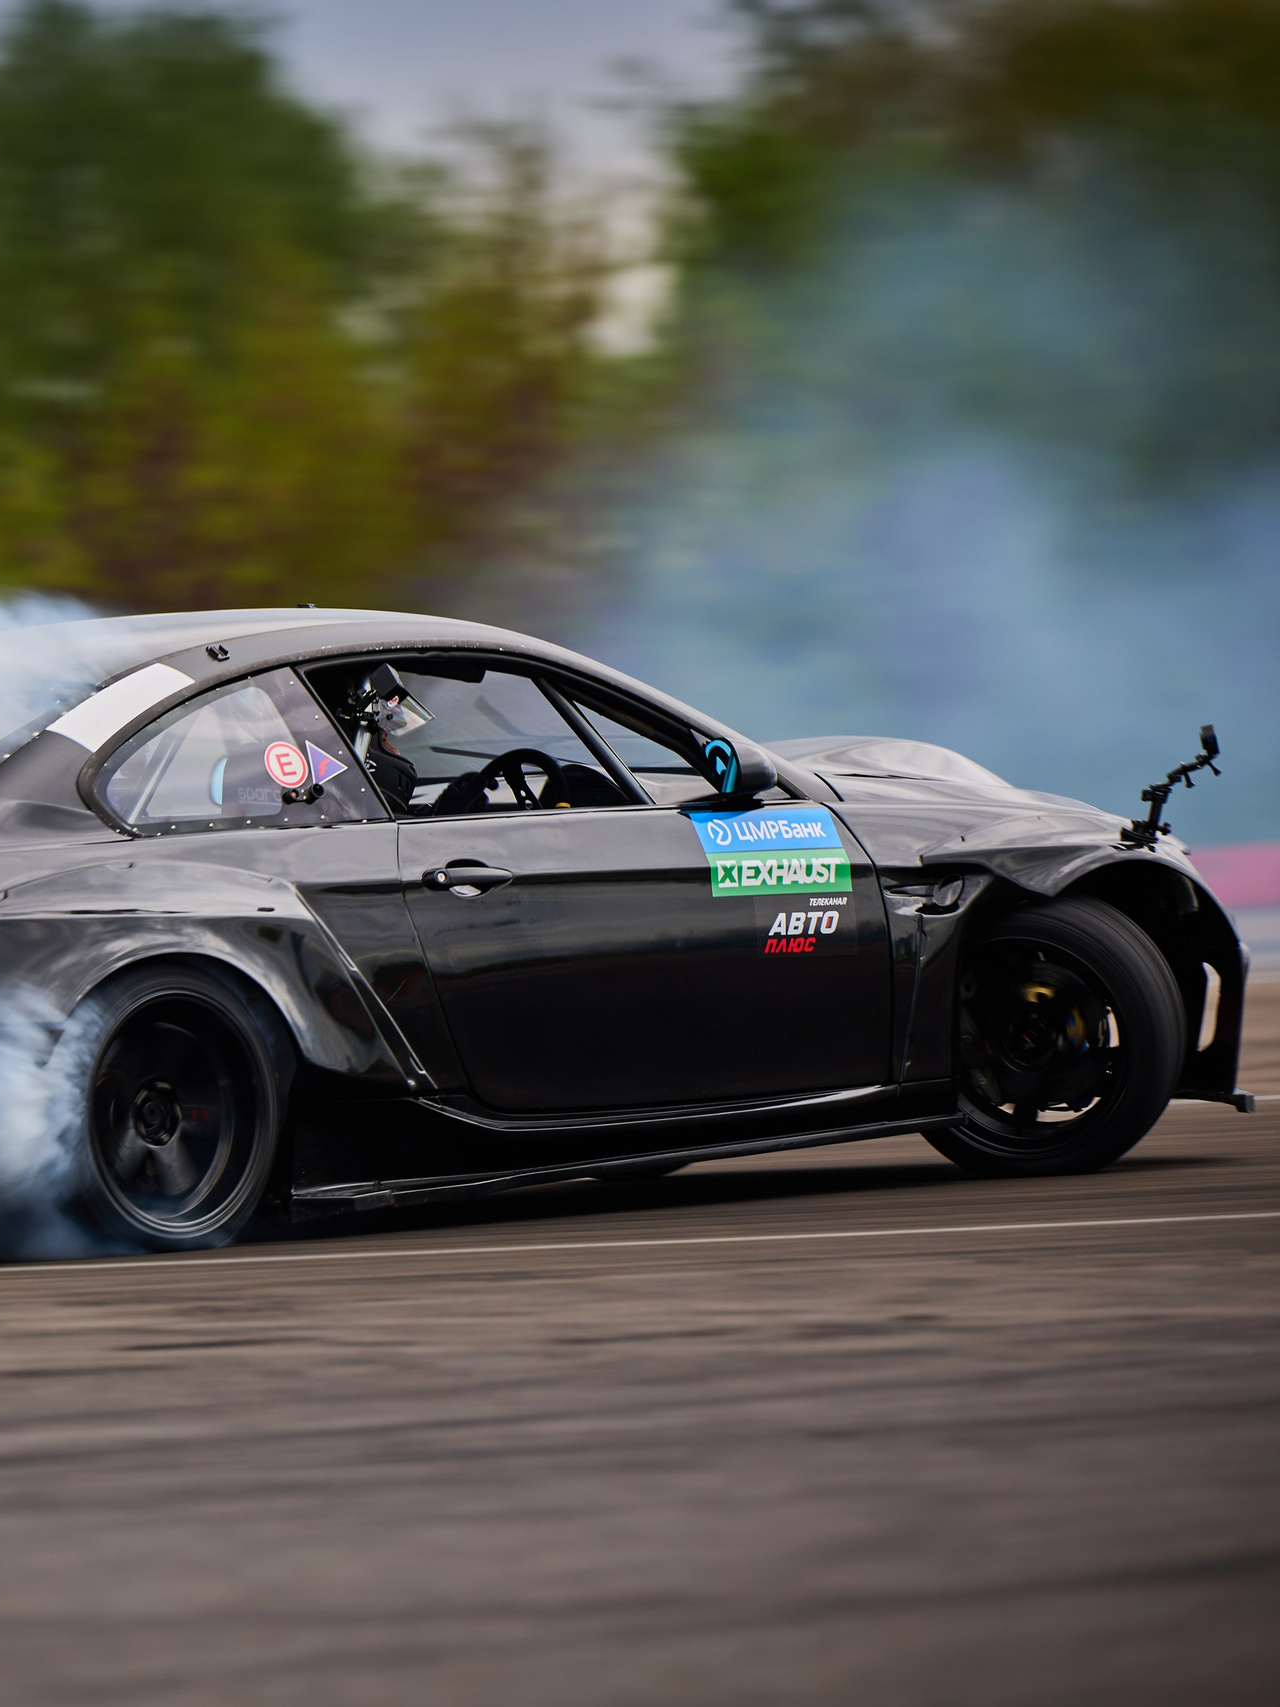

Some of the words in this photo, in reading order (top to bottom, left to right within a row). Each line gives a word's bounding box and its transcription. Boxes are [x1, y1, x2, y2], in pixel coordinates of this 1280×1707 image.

[275, 753, 297, 776] E
[238, 787, 281, 805] sparc
[733, 820, 826, 842] ЦМРБанк
[741, 857, 842, 886] EXHAUST
[809, 897, 848, 906] ТЕЛЕКАНАЛ
[768, 911, 840, 936] АВТО
[764, 937, 816, 953] ПЛЮС
